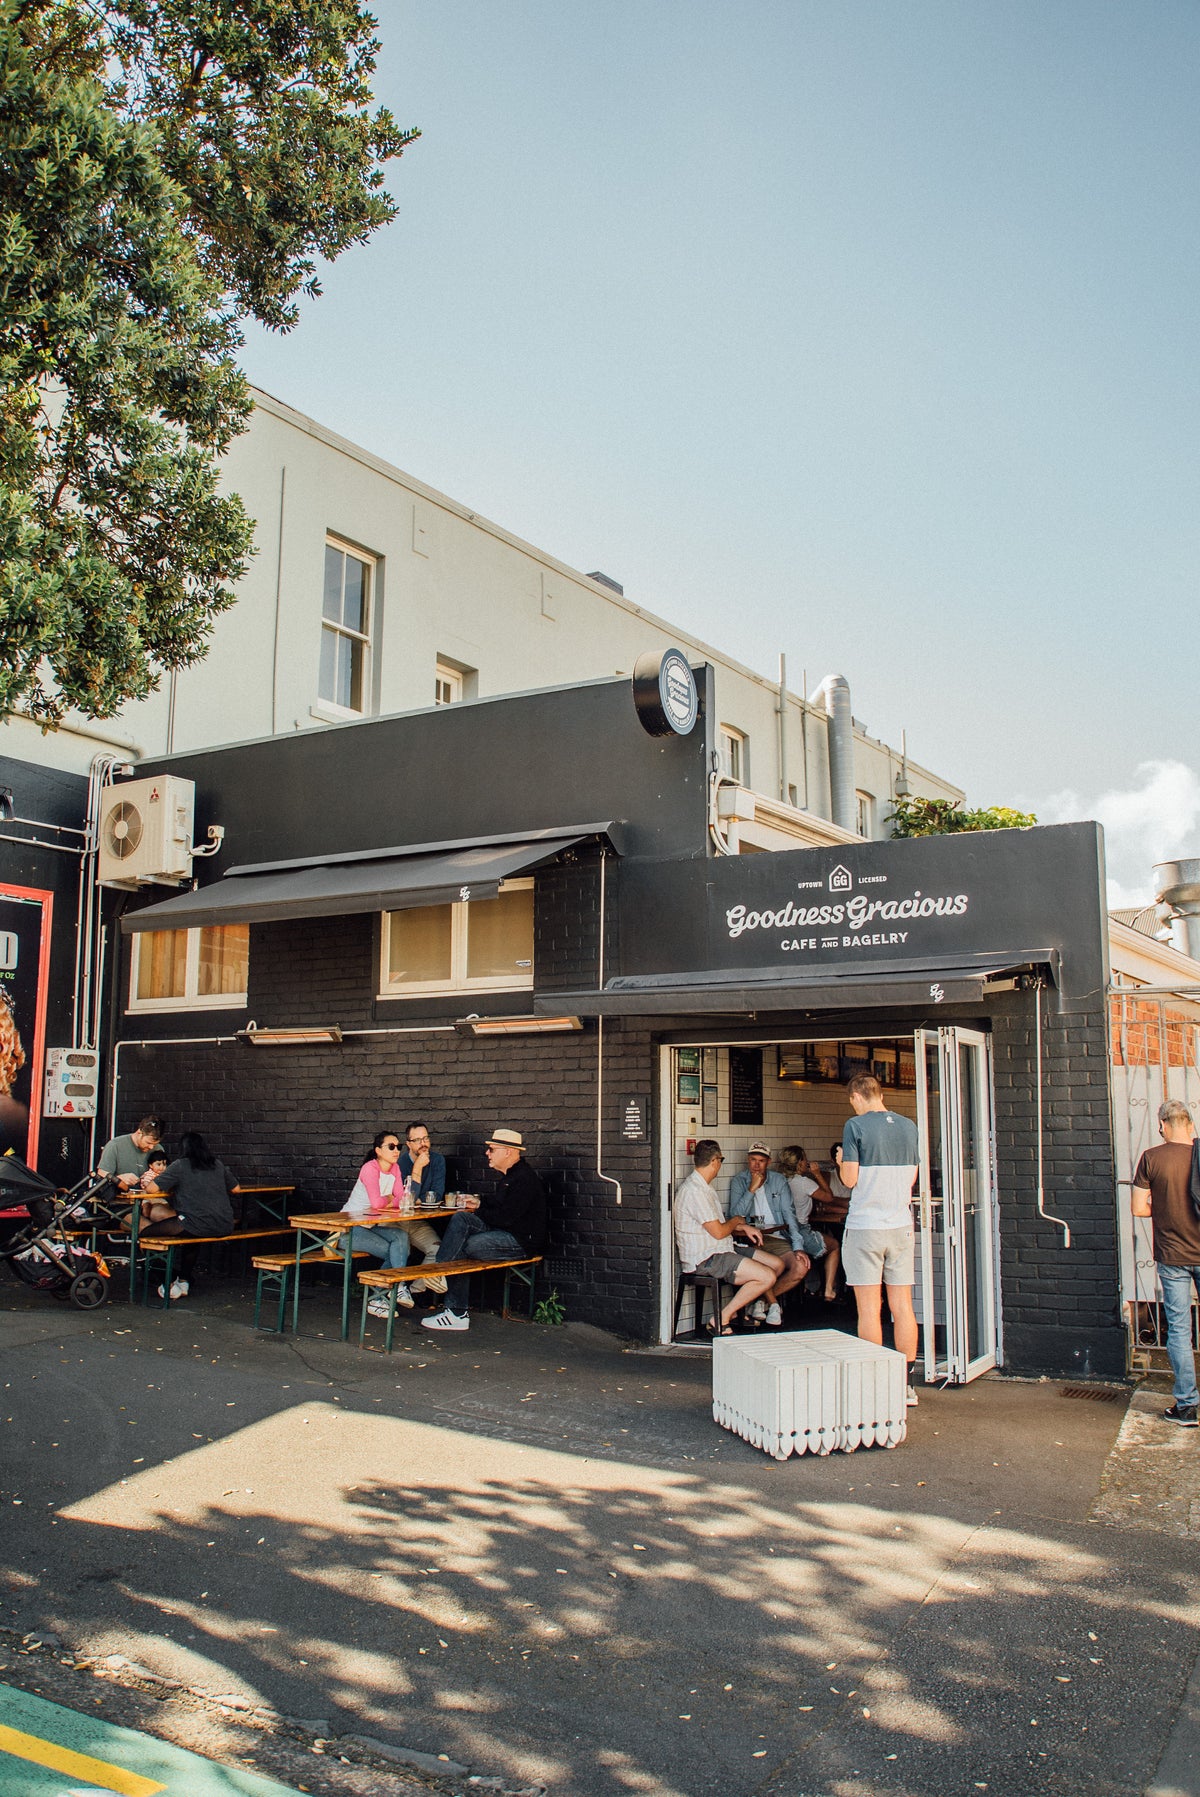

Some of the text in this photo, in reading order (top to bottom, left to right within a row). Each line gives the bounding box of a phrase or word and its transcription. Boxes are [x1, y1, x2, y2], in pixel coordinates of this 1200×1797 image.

[797, 881, 823, 889] UPTOWN
[833, 875, 848, 887] GG
[858, 875, 888, 884] LICENSED
[726, 890, 969, 938] Goodness Gracious
[780, 932, 909, 951] CAFE AND BAGELRY
